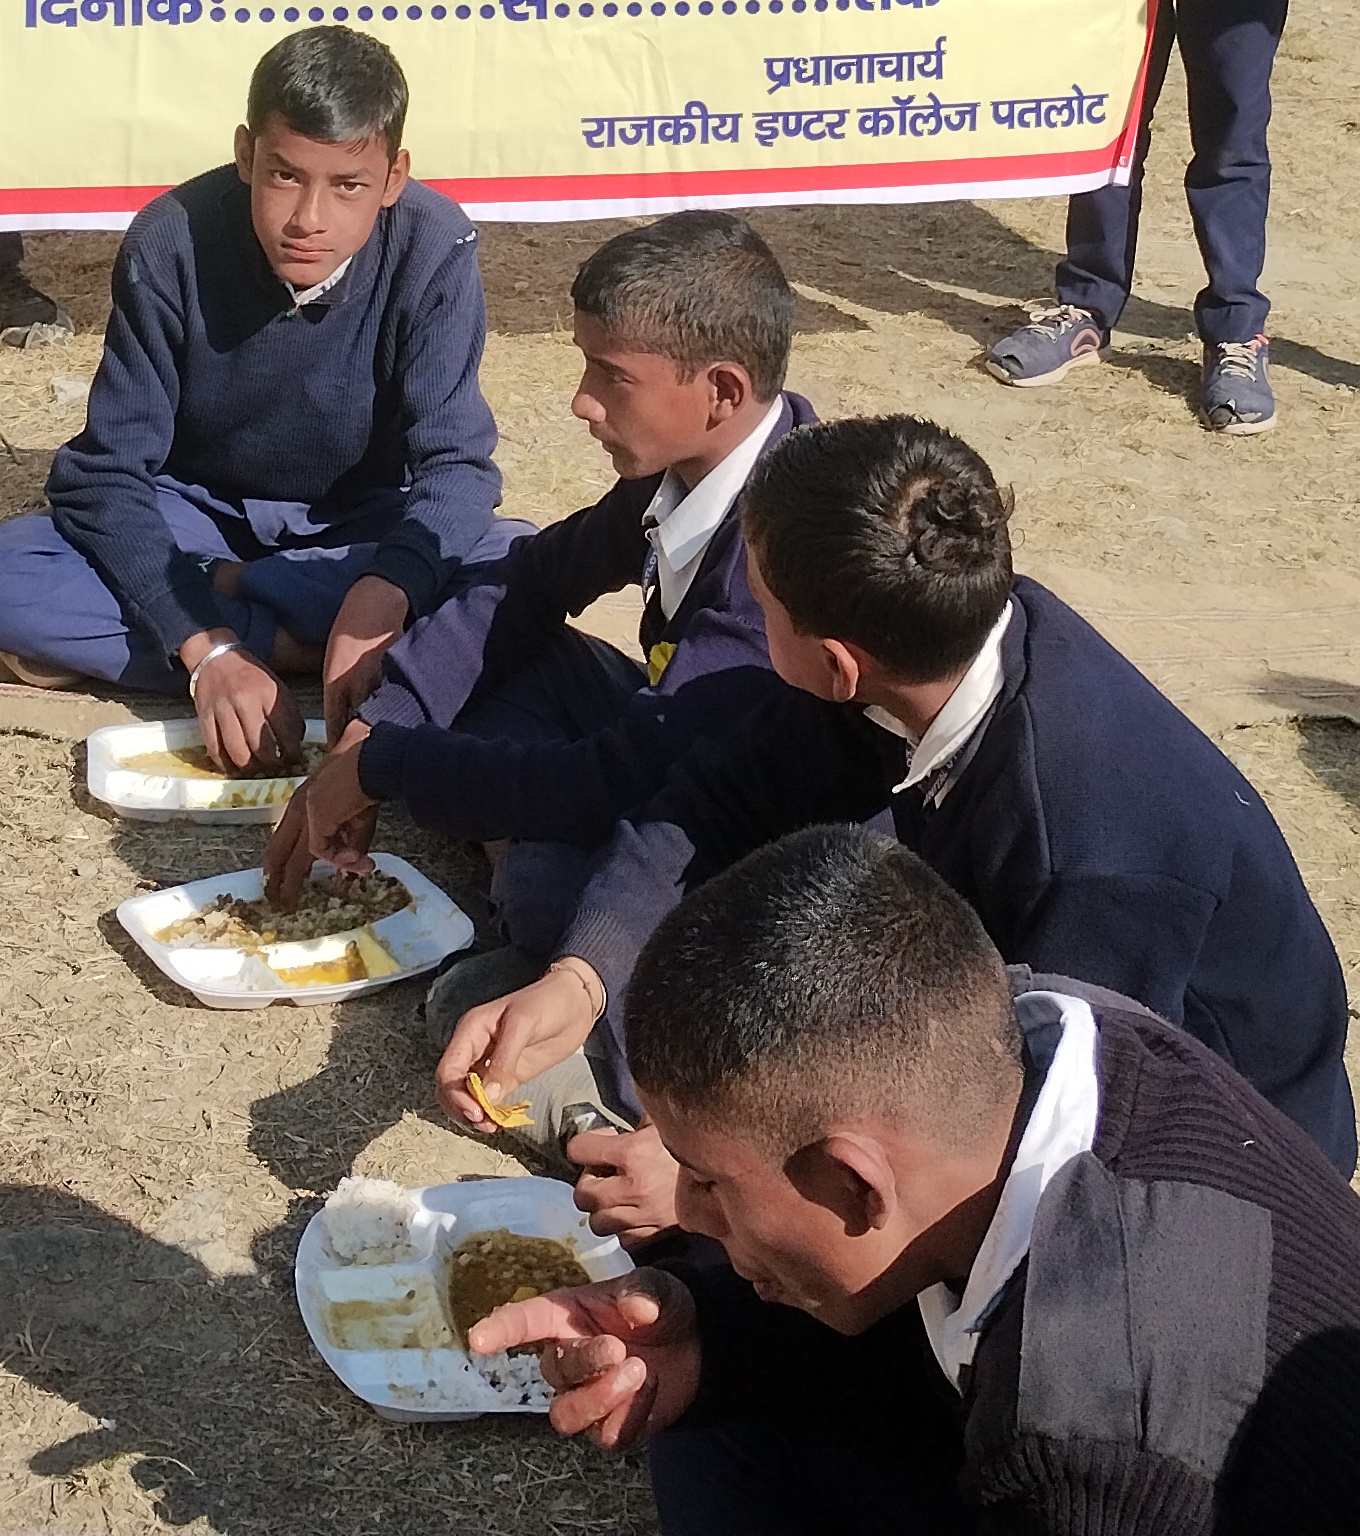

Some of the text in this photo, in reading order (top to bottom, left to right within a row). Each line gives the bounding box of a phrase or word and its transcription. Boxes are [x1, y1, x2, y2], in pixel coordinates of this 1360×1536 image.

[764, 35, 947, 94] प्रधानाचार्य
[581, 83, 1110, 150] राजकीय इण्टर कॉलेज पतलोट
